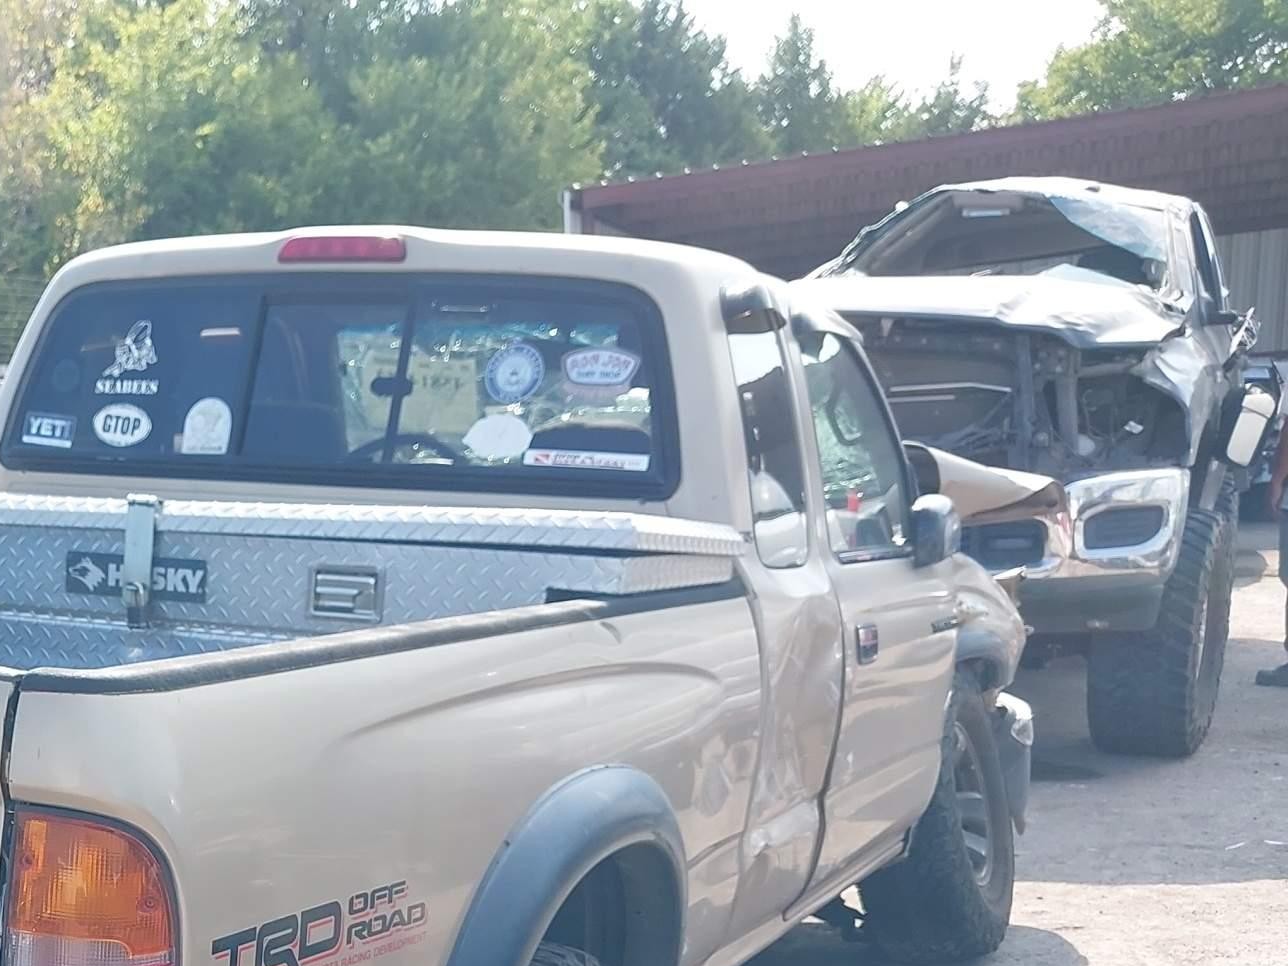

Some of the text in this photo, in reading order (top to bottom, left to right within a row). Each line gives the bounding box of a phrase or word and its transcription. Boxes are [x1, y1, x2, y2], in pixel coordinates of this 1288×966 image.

[95, 379, 158, 394] SEABEES
[30, 415, 72, 440] YETI
[102, 414, 141, 437] GTOP
[108, 563, 204, 593] HSKY
[347, 880, 407, 916] OFF
[346, 902, 426, 945] ROAD
